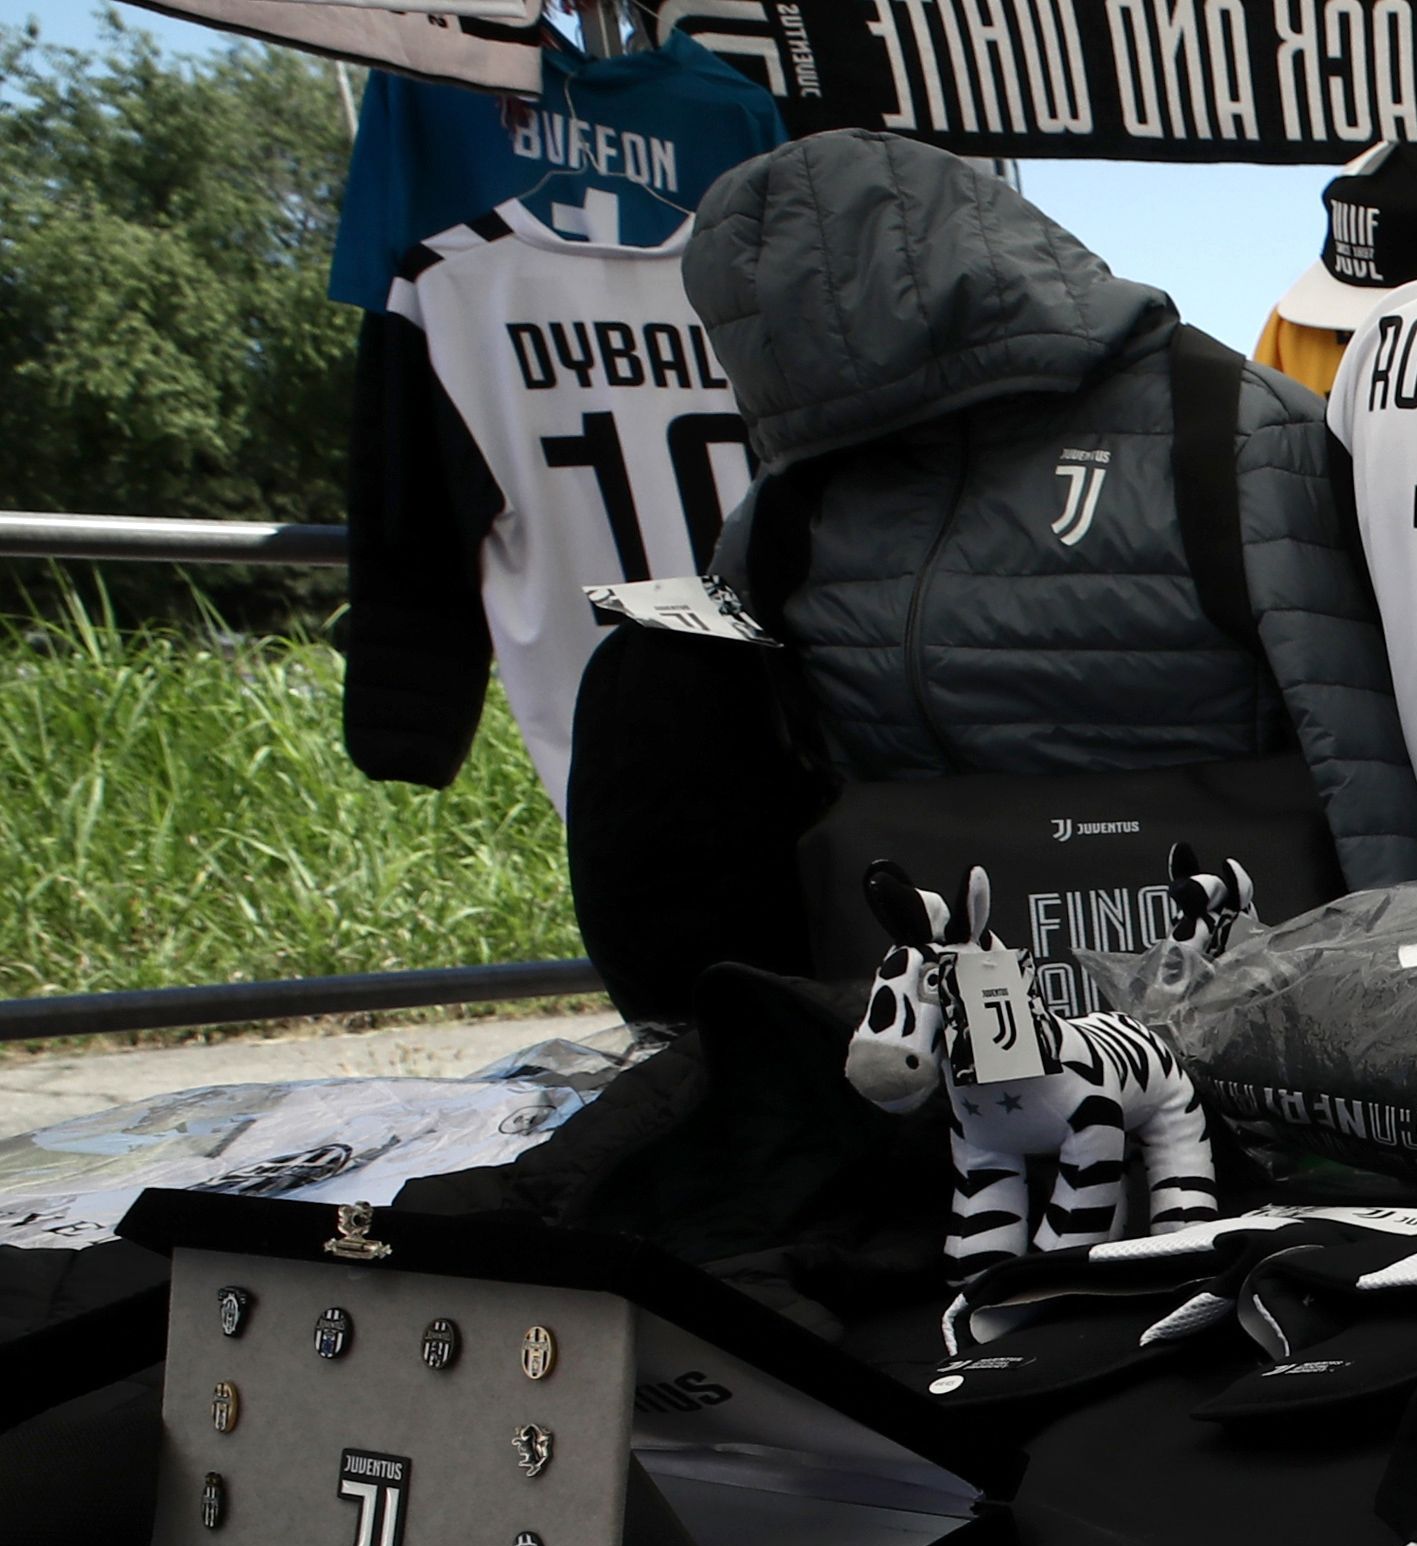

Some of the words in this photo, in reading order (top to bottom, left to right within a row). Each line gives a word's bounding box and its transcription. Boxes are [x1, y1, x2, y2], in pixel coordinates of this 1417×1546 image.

[512, 111, 679, 192] BUFFON
[506, 321, 729, 390] DYBAL
[1077, 820, 1140, 836] JUVENTUS
[1027, 884, 1174, 958] FINO
[345, 1455, 404, 1482] JUVENTUS
